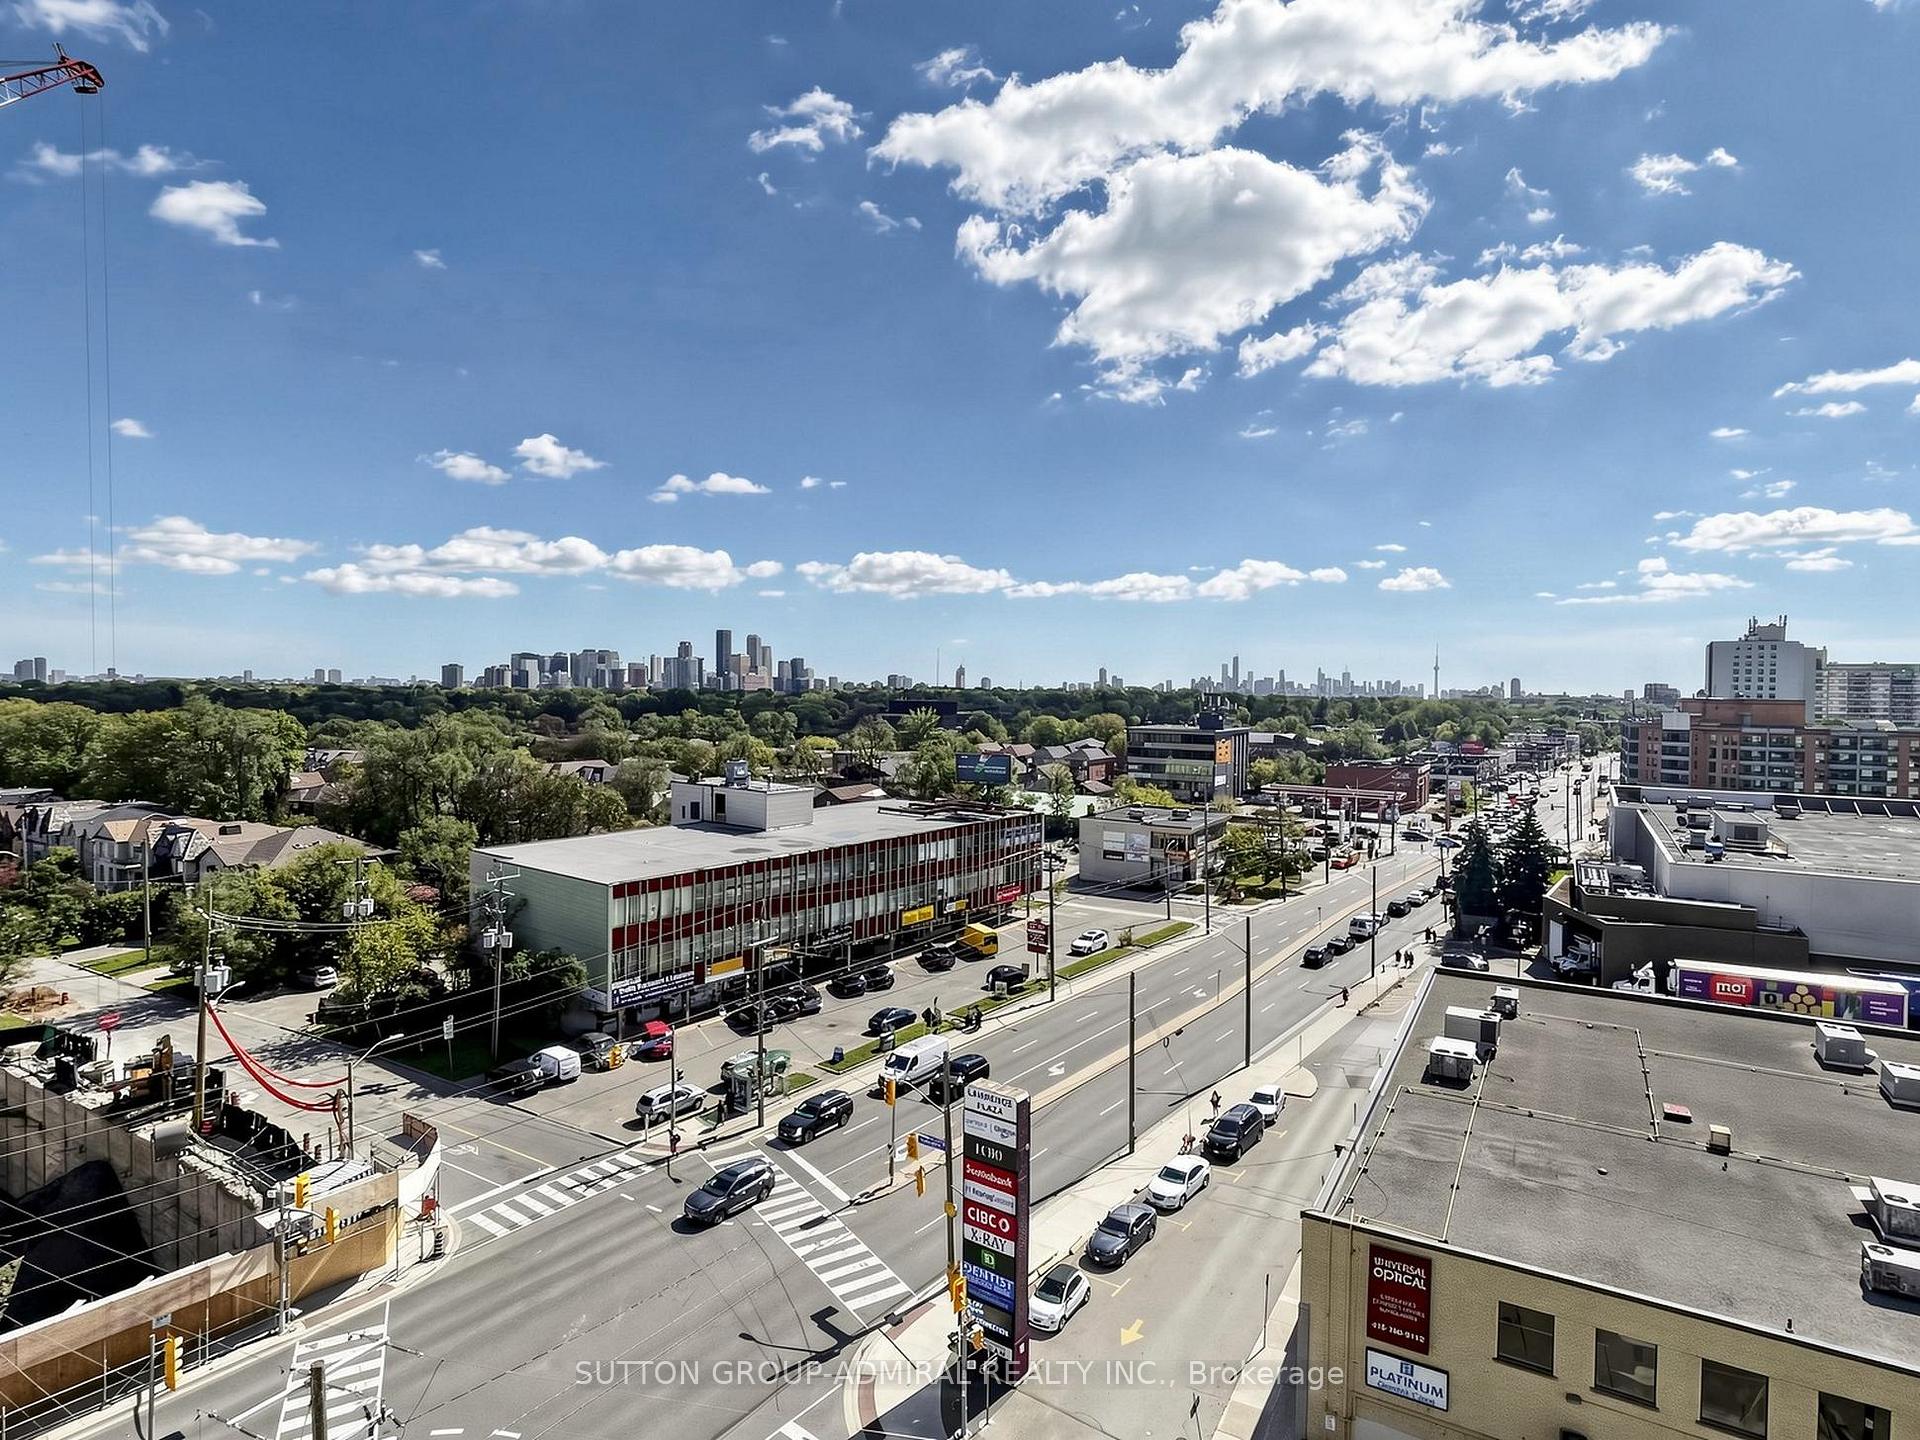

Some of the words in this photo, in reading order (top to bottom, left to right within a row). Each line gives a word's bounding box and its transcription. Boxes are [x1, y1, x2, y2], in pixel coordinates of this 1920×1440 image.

[966, 1163, 1012, 1188] Scotiabank
[967, 1207, 997, 1228] CIBC
[963, 1262, 1014, 1291] DENTIST
[1374, 1257, 1427, 1279] UNIVERSAL
[1370, 1366, 1444, 1399] PLATINUM
